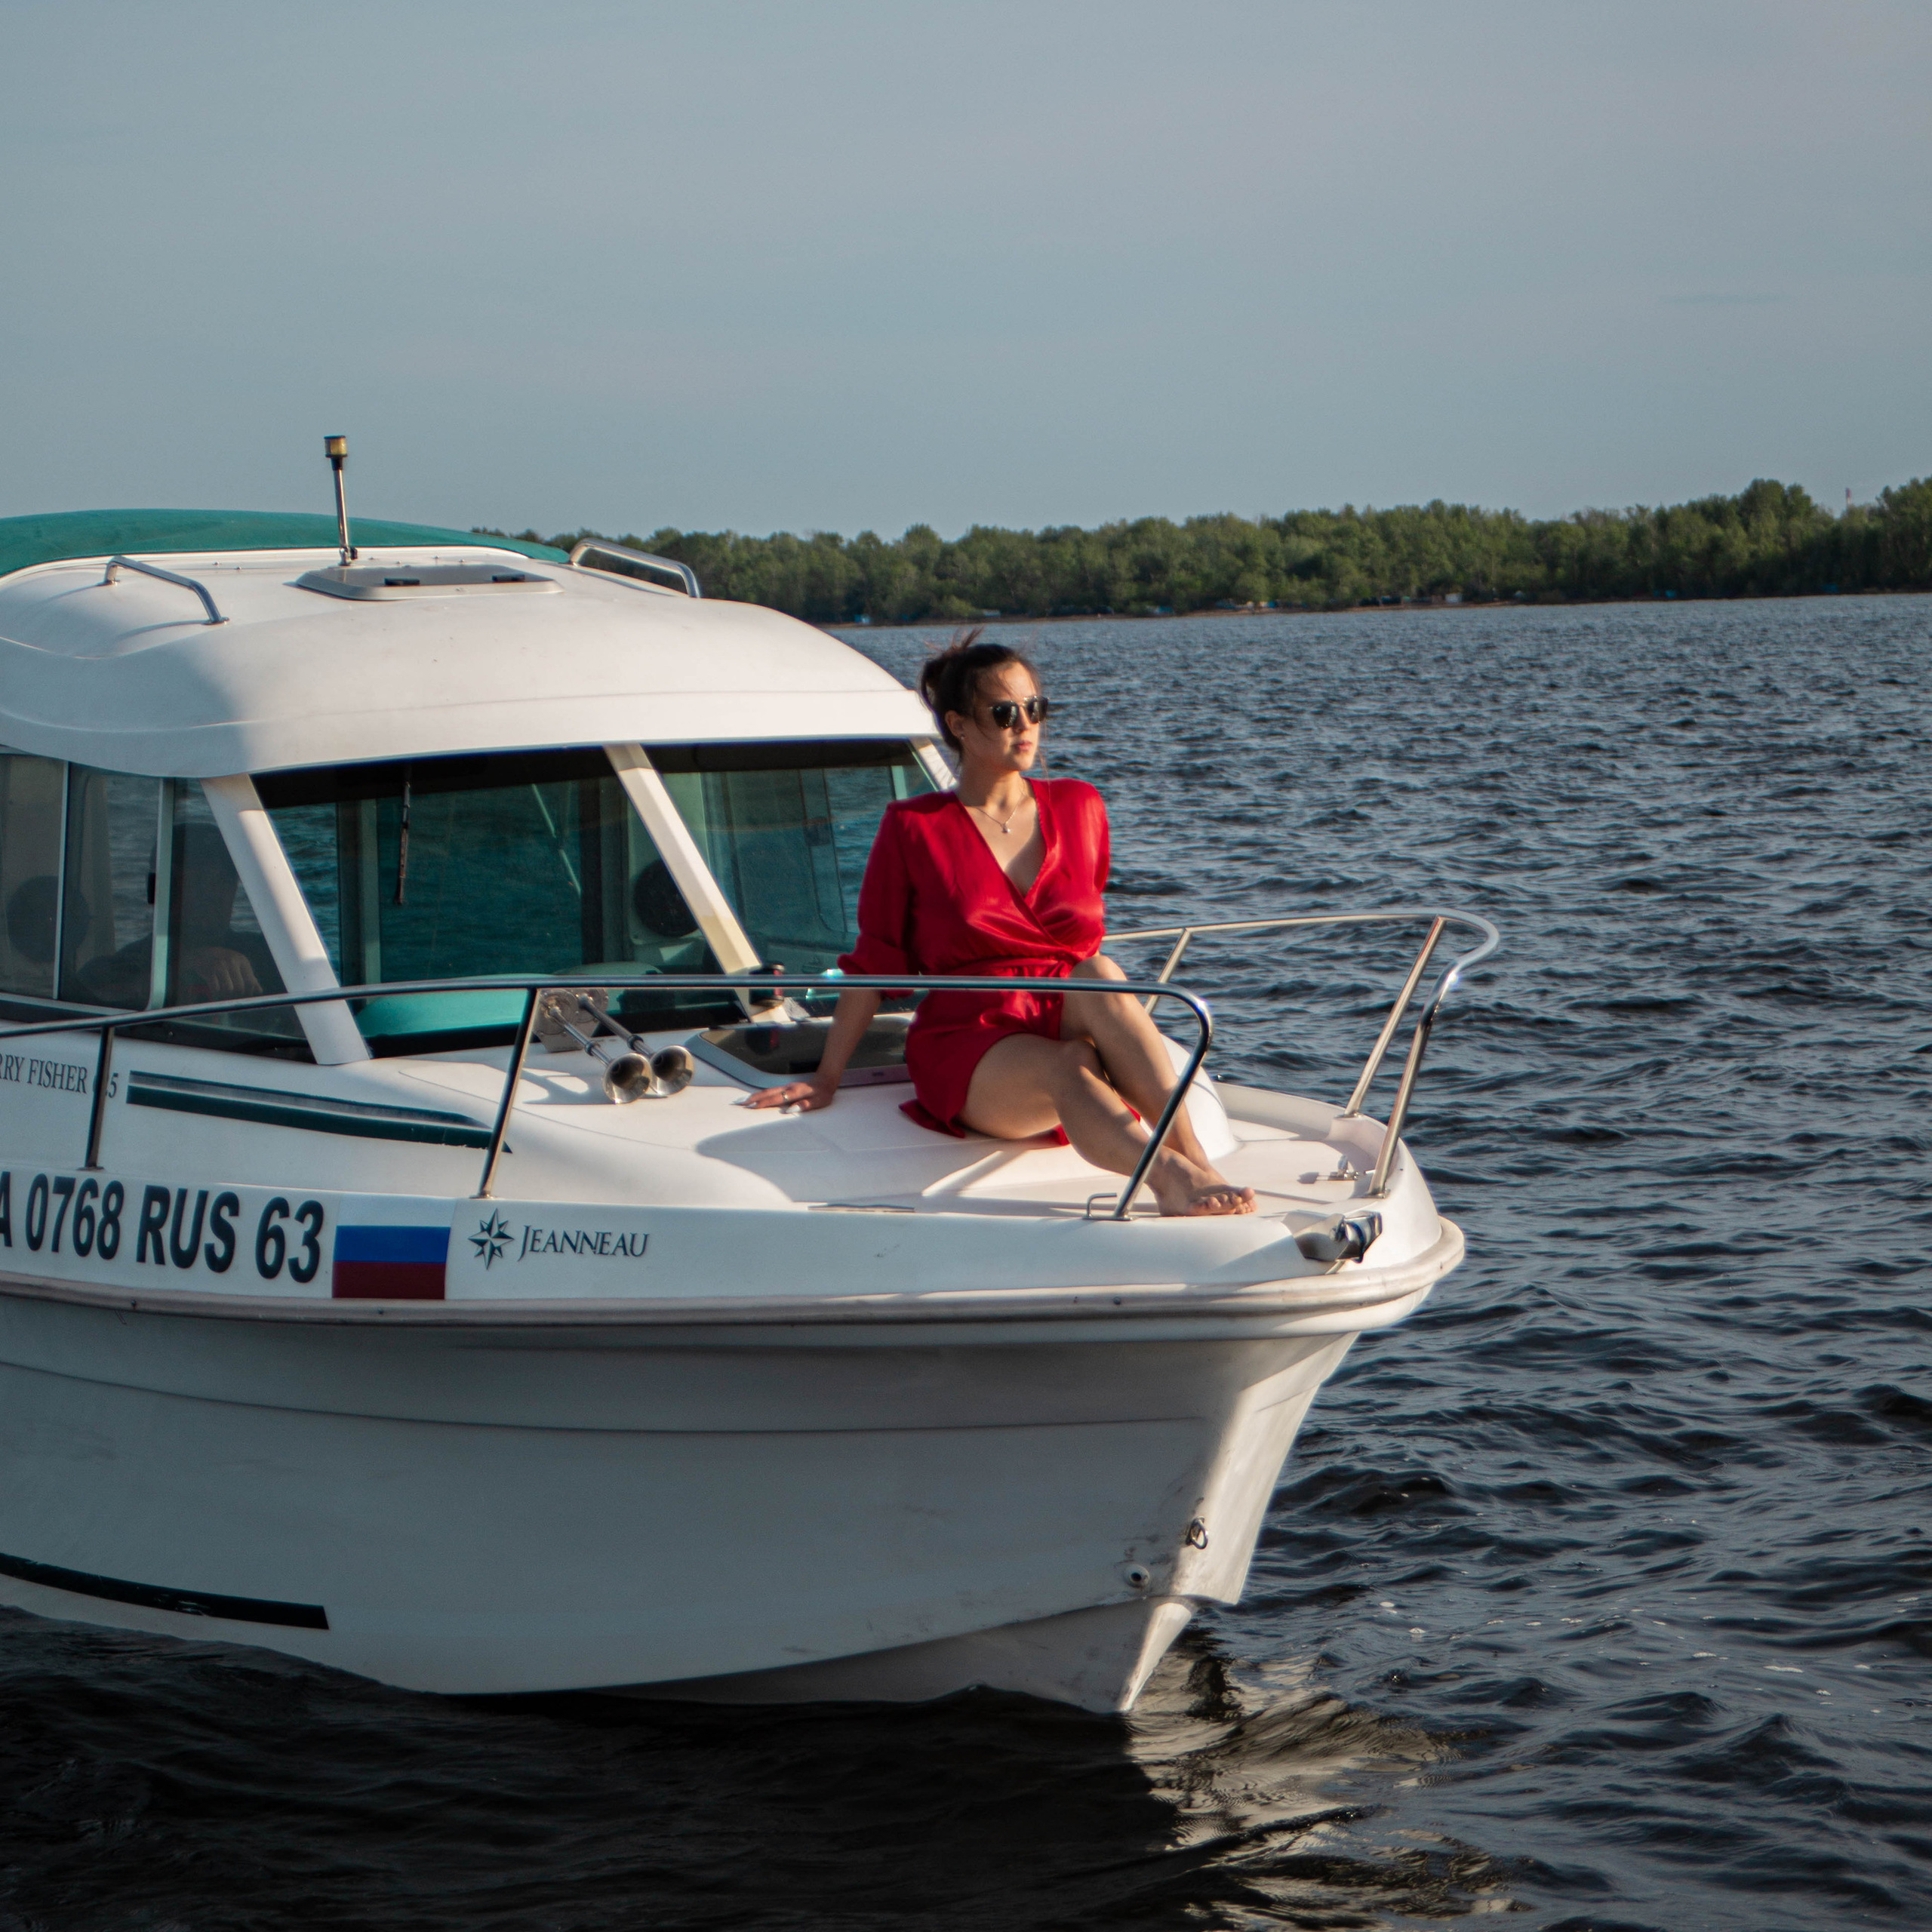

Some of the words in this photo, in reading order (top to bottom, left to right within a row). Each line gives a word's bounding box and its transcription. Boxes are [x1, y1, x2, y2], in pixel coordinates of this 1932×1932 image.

[0, 1054, 24, 1082] RY
[27, 1058, 88, 1094] FISHER
[25, 1173, 125, 1260] 0768
[136, 1184, 240, 1273] RUS
[255, 1196, 325, 1283] 63
[518, 1225, 649, 1262] JEANNEAU
